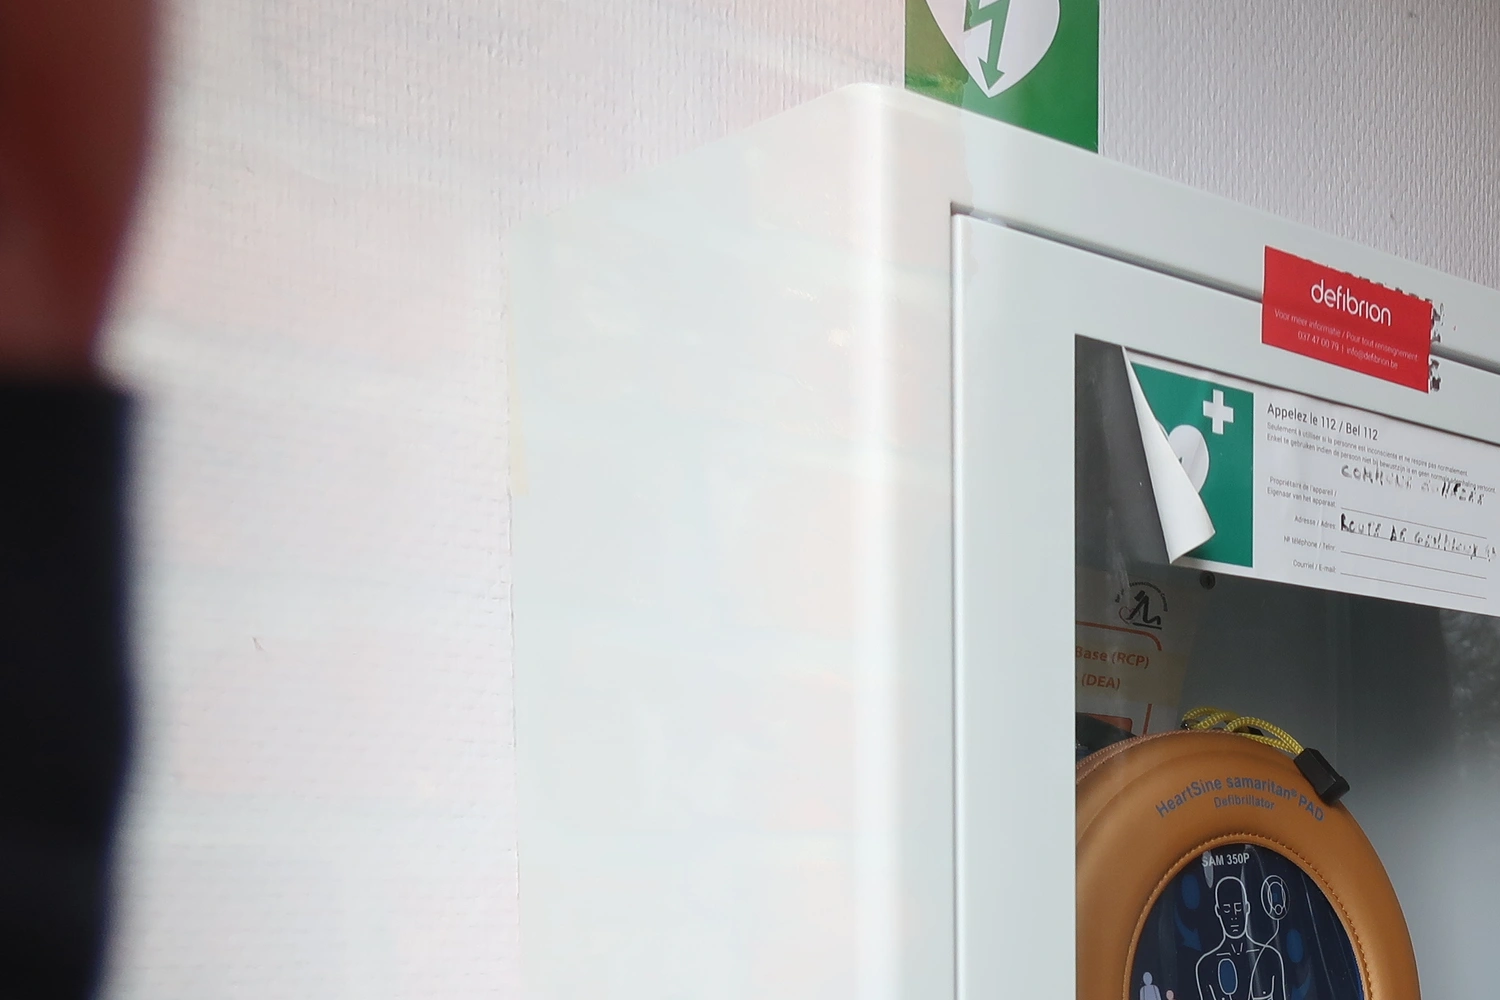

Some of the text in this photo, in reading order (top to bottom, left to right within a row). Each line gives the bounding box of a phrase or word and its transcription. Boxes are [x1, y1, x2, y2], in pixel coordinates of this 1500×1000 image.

[1311, 279, 1392, 326] defibrion
[1267, 403, 1307, 422] Appelez
[1310, 412, 1318, 425] le
[1321, 416, 1336, 430] 112
[1345, 422, 1360, 435] Bel
[1364, 426, 1378, 440] 112
[1076, 646, 1150, 669] Base (RCP)
[1082, 674, 1121, 690] (DEA)
[1155, 777, 1223, 818] HeartSine
[1298, 794, 1325, 821] PAD
[1214, 794, 1275, 811] Defibrillator
[1201, 852, 1250, 867] SAM 350P
